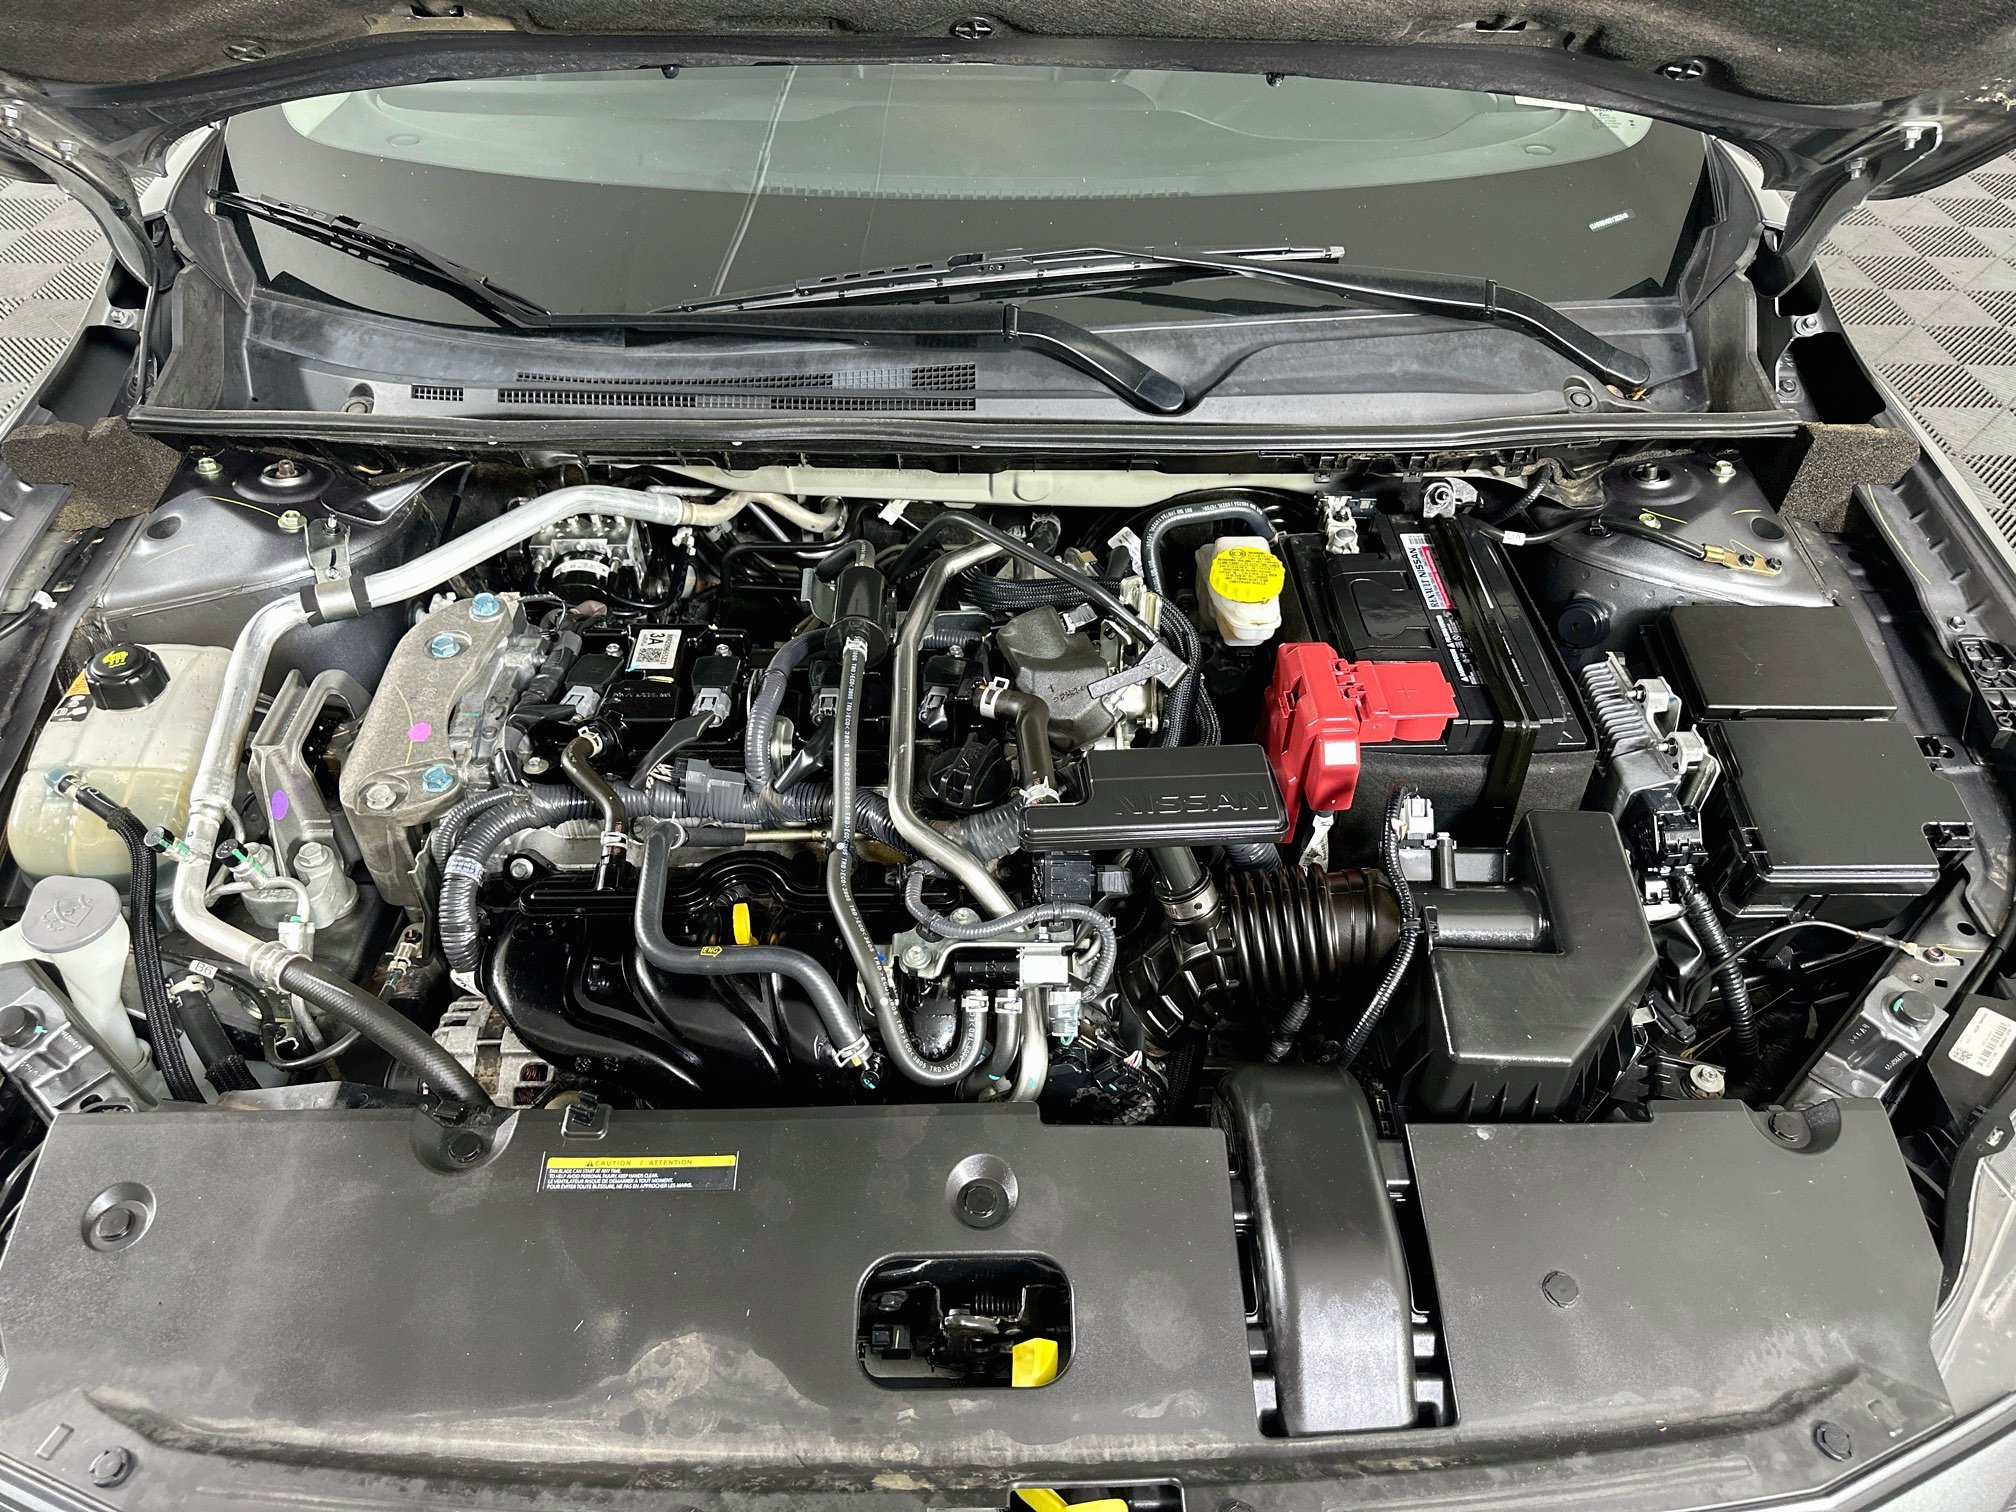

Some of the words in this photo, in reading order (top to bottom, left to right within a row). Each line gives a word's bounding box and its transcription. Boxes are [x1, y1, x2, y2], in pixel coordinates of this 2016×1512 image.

[1408, 547, 1427, 577] NISSAN
[1421, 579, 1439, 607] RENAULT
[1114, 790, 1269, 815] NISSAN
